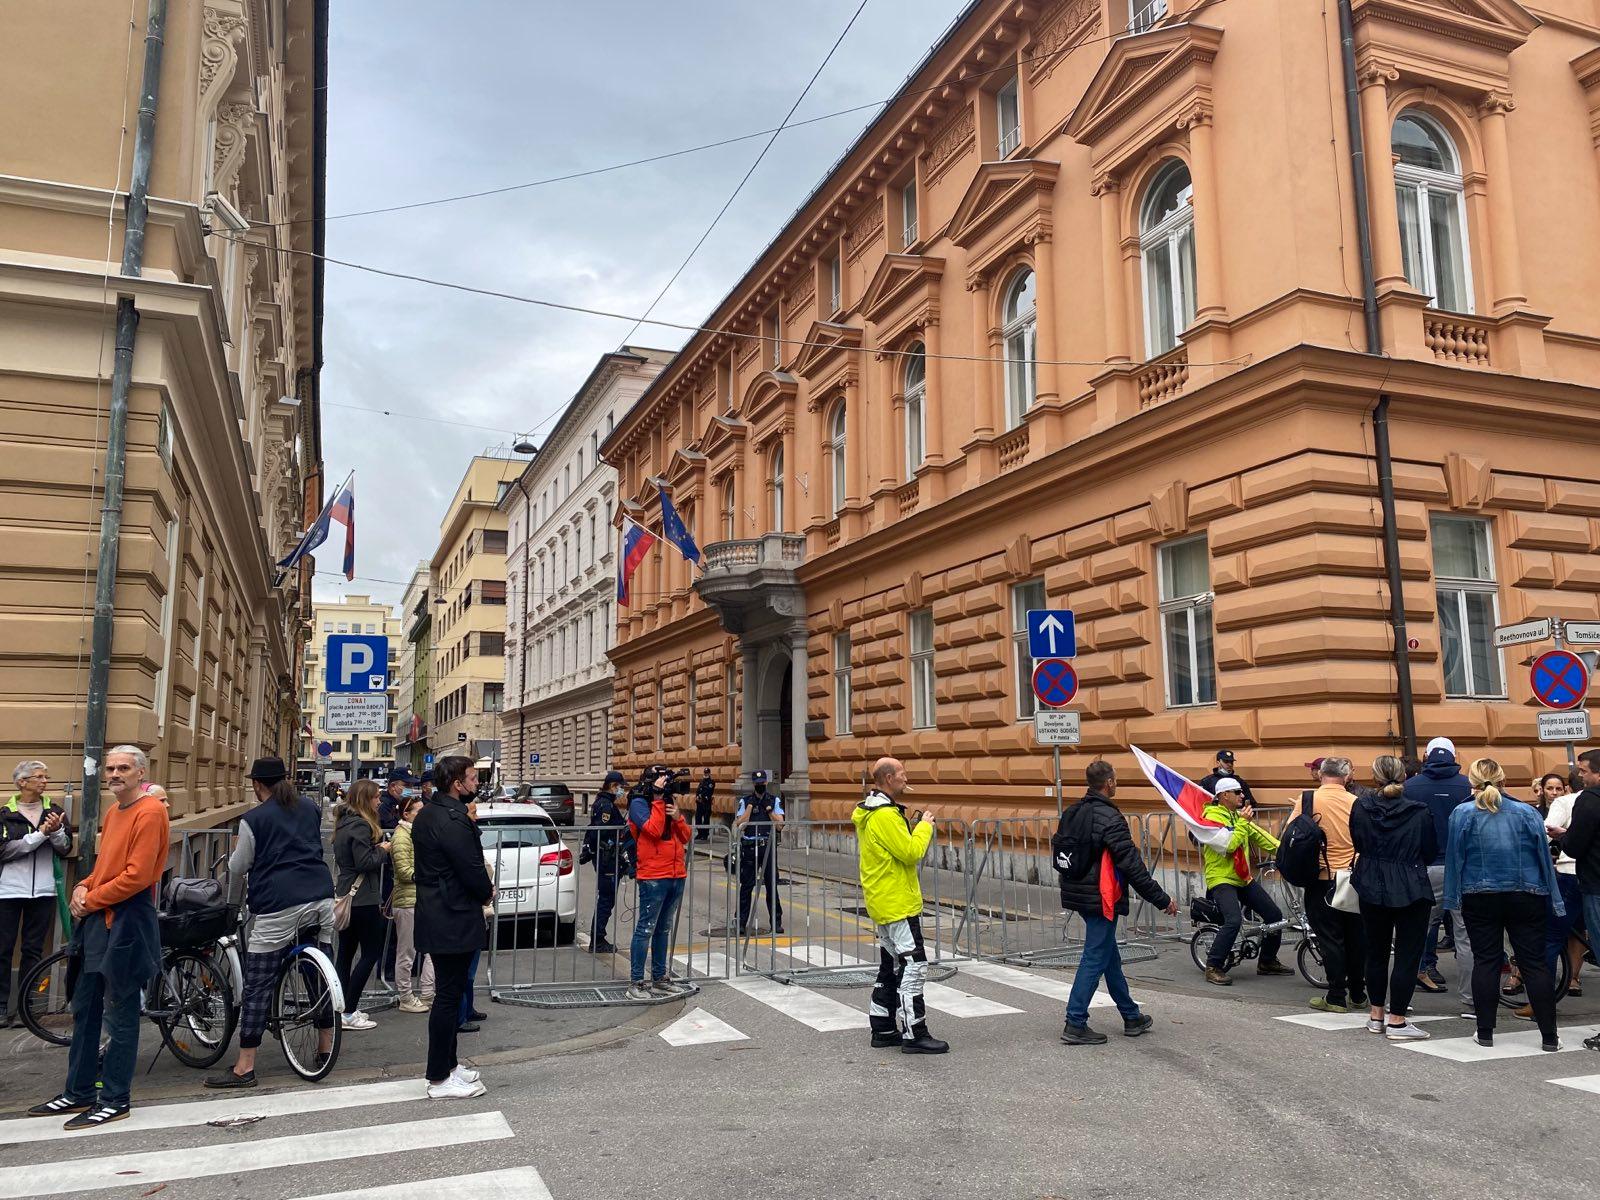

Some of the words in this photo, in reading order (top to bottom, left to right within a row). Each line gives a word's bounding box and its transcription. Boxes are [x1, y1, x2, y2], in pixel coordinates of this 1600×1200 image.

[1500, 630, 1537, 642] Beethovnova
[1538, 627, 1546, 636] ul.
[341, 643, 374, 685] P
